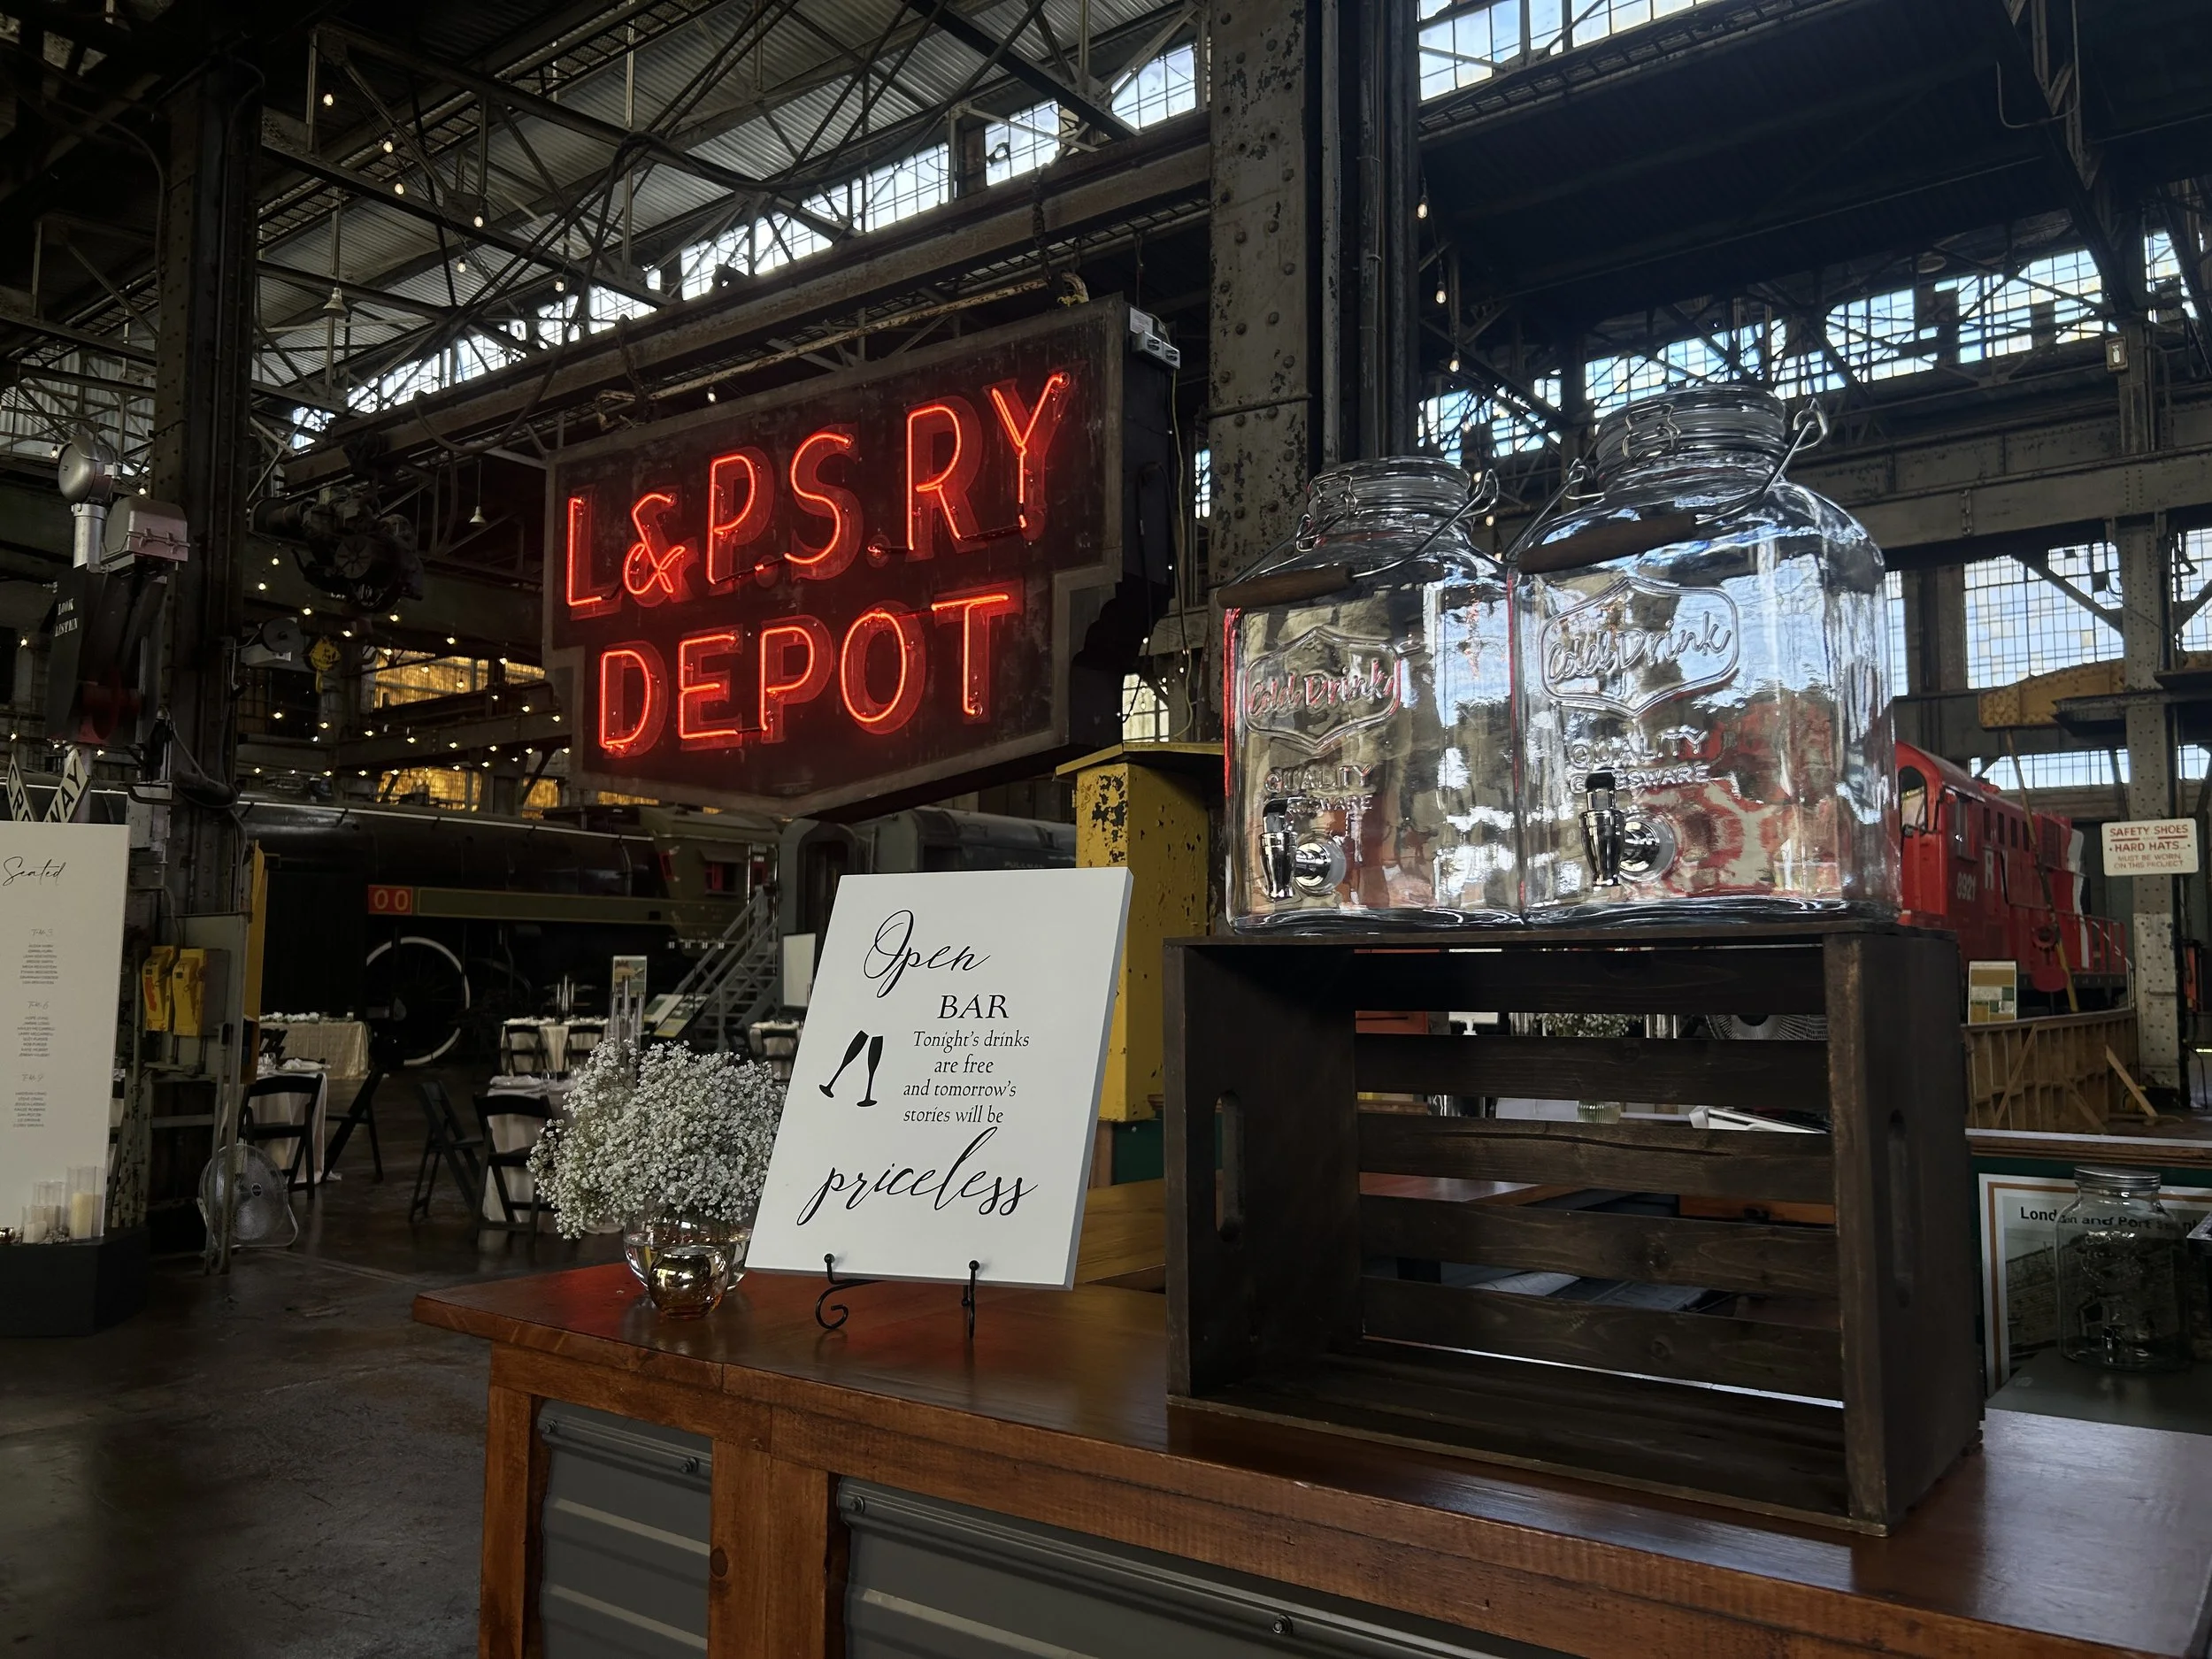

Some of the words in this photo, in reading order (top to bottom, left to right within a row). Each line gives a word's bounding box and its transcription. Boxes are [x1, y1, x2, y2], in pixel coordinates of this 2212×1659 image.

[1617, 611, 1732, 670] Drink
[599, 584, 1022, 761] DEPOT
[1304, 657, 1394, 710] Drink
[1571, 726, 1709, 767] QUALITY
[1263, 763, 1374, 795] QUALITY
[2109, 826, 2150, 838] SAFETY
[2154, 824, 2188, 835] SHOES
[2115, 842, 2145, 853] HARD
[2154, 852, 2181, 861] WORN
[3, 856, 67, 887] Seated
[864, 910, 991, 999] Open
[937, 994, 1010, 1019] BAR
[913, 1030, 979, 1054] Tonight's
[983, 1029, 1030, 1048] drinks
[933, 1061, 959, 1073] are
[963, 1053, 995, 1073] free
[902, 1078, 931, 1096] and
[933, 1079, 1017, 1097] tomorrow's
[902, 1106, 951, 1123] stories
[955, 1104, 984, 1123] will
[987, 1104, 1004, 1124] be
[796, 1125, 1039, 1226] priceless
[2081, 1217, 2115, 1226] and
[2117, 1217, 2151, 1230] Port
